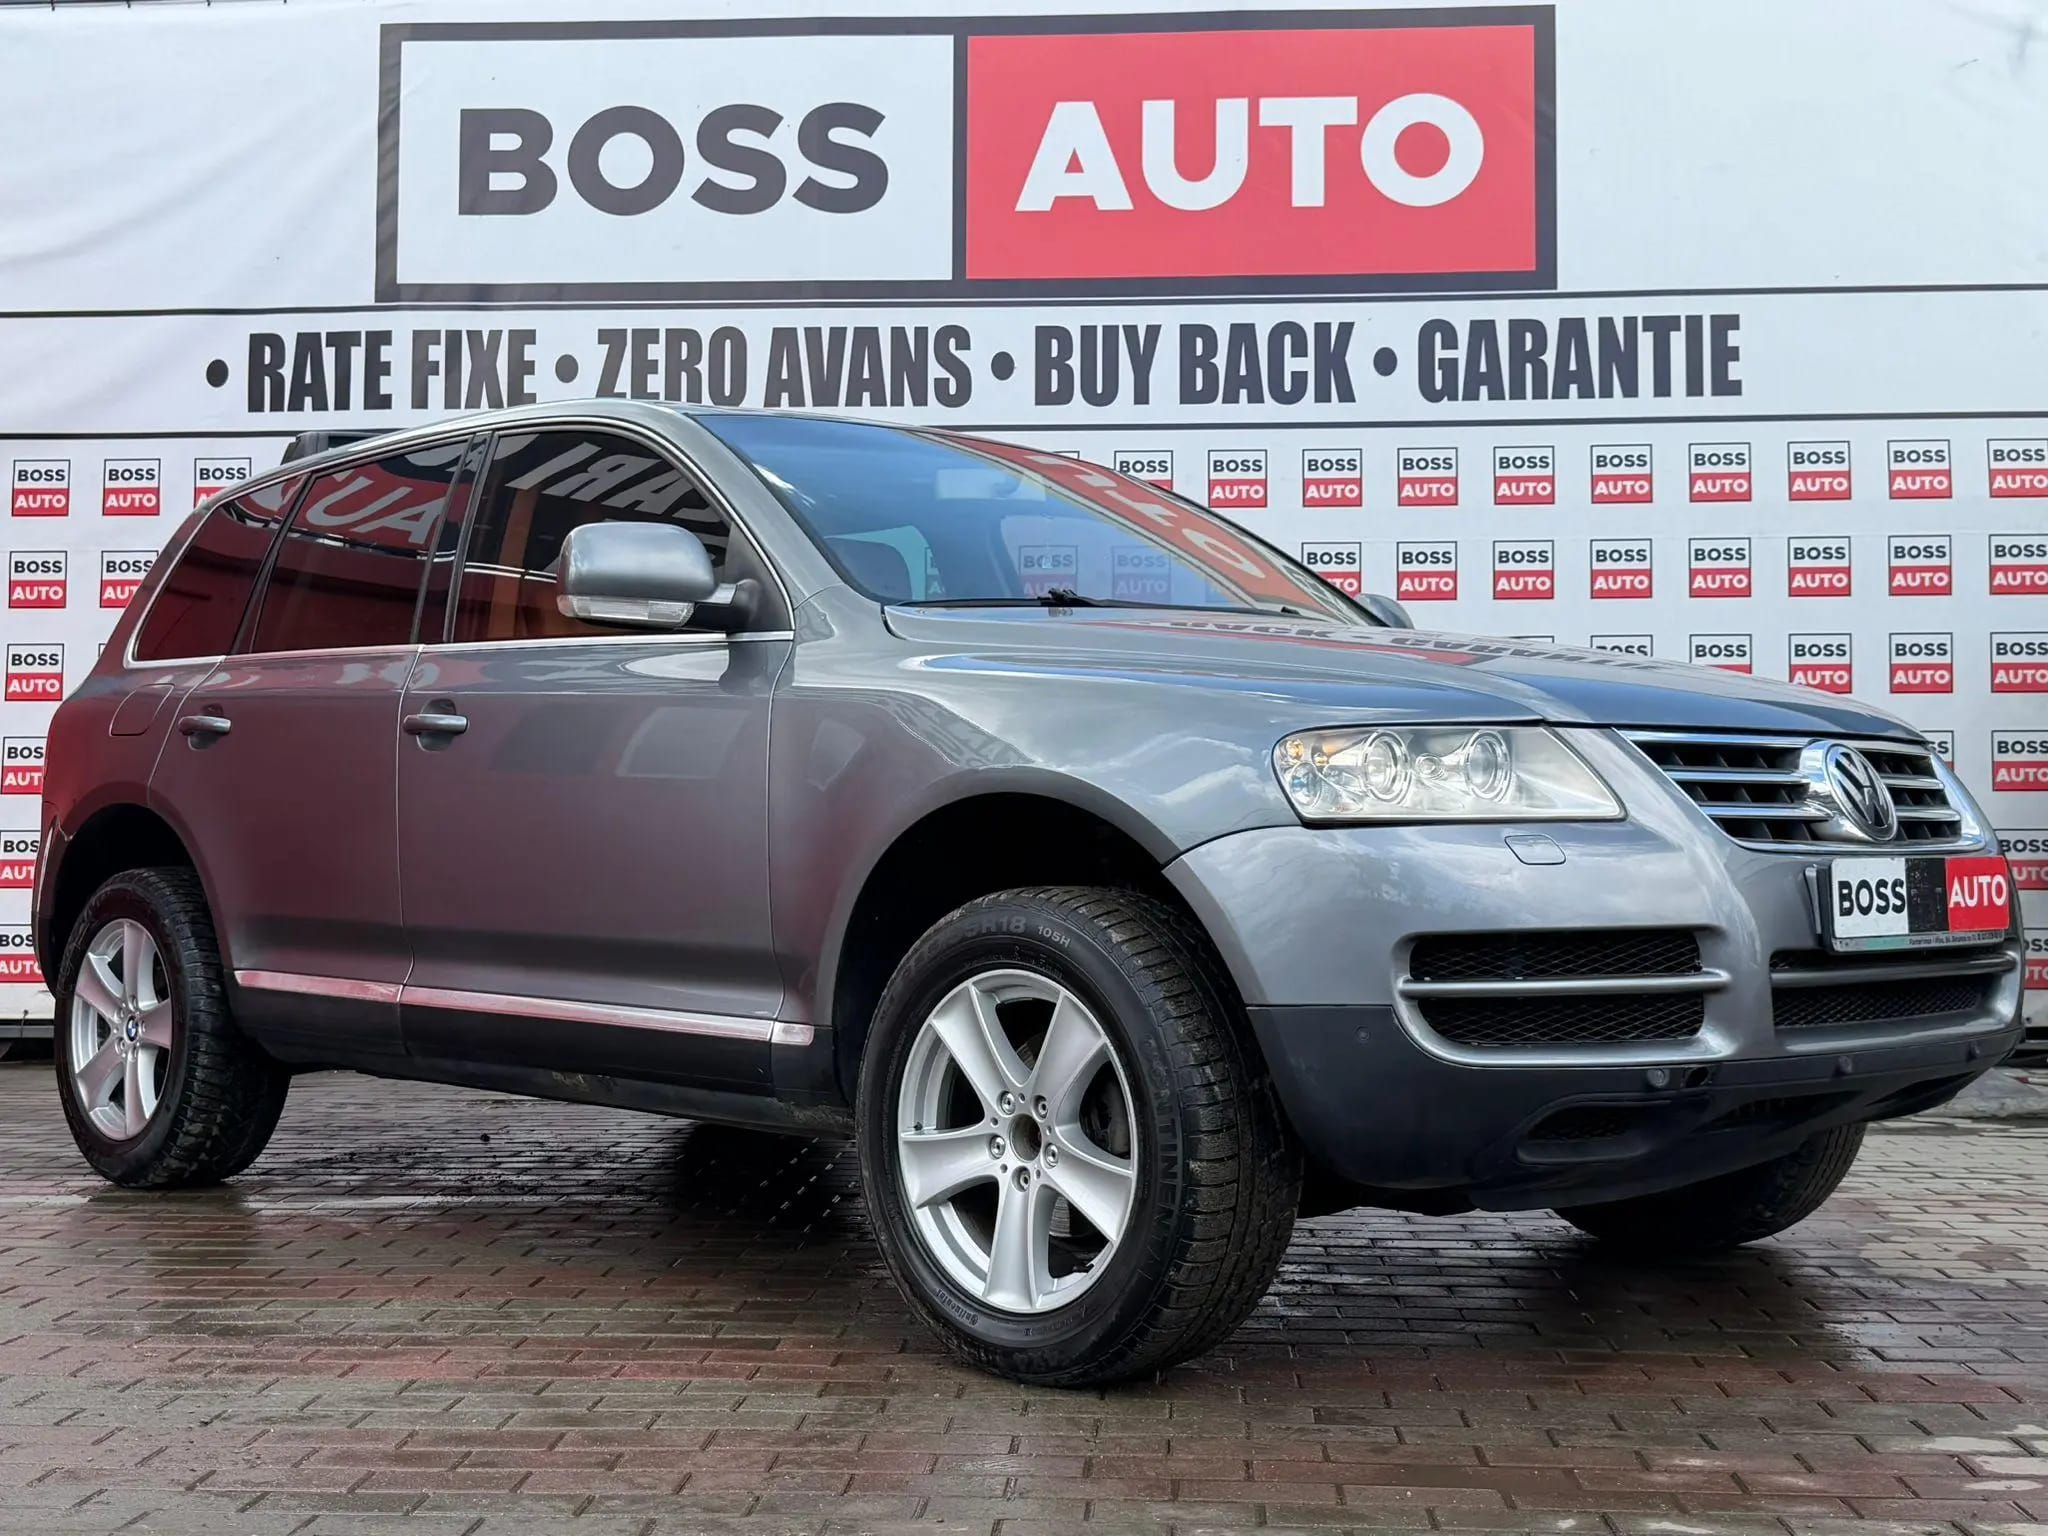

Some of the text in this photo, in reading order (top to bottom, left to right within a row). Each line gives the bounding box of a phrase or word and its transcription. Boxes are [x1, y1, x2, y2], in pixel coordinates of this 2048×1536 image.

[457, 91, 1486, 217] BOSS AUTO
[248, 312, 1744, 413] RATE FIXE ZERO AVANS BUY BACK GARANTIE
[1498, 455, 1550, 470] BOSS
[1596, 453, 1648, 468] BOSS
[1694, 452, 1747, 467] BOSS
[1793, 450, 1846, 465] BOSS
[1893, 449, 1946, 464] BOSS
[1992, 448, 2046, 462] BOSS
[1119, 460, 1169, 473] BOSS
[1213, 459, 1263, 473] BOSS
[1307, 458, 1358, 472] BOSS
[1402, 457, 1454, 471] BOSS
[17, 468, 66, 482] BOSS
[108, 467, 156, 482] BOSS
[199, 467, 247, 481] BOSS
[1992, 474, 2048, 489] AUTO
[1400, 482, 1455, 498] AUTO
[1496, 481, 1552, 497] AUTO
[1593, 480, 1650, 496] AUTO
[1692, 478, 1749, 494] AUTO
[1791, 477, 1849, 492] AUTO
[1892, 475, 1949, 491] AUTO
[1210, 484, 1265, 500] AUTO
[1305, 484, 1360, 499] AUTO
[14, 494, 67, 508] AUTO
[105, 493, 157, 508] AUTO
[1401, 550, 1453, 565] BOSS
[1498, 550, 1549, 564] BOSS
[1595, 548, 1648, 563] BOSS
[1694, 547, 1746, 562] BOSS
[1793, 546, 1846, 561] BOSS
[1893, 544, 1947, 560] BOSS
[1994, 543, 2048, 558] BOSS
[1306, 551, 1357, 566] BOSS
[14, 560, 63, 574] BOSS
[1400, 577, 1455, 592] AUTO
[1496, 576, 1551, 591] AUTO
[1593, 575, 1650, 590] AUTO
[1692, 574, 1749, 589] AUTO
[1791, 573, 1848, 588] AUTO
[1891, 572, 1949, 587] AUTO
[1992, 571, 2048, 586] AUTO
[11, 585, 64, 601] AUTO
[102, 586, 138, 601] AUT
[1695, 644, 1747, 658] BOSS
[1794, 643, 1847, 658] BOSS
[1895, 642, 1948, 657] BOSS
[1995, 641, 2048, 656] BOSS
[11, 653, 59, 667] BOSS
[1793, 670, 1849, 686] AUTO
[1892, 669, 1951, 685] AUTO
[1993, 669, 2048, 684] AUTO
[7, 678, 60, 693] AUTO
[7, 746, 44, 760] BOS
[1997, 740, 2048, 755] BOSS
[3, 772, 43, 787] AUT
[1995, 767, 2048, 783] AUTO
[2, 839, 40, 853] BOS
[0, 865, 36, 880] AUT
[1838, 874, 2007, 917] BOSS AUTO
[0, 933, 33, 948] BOS
[1037, 924, 1072, 949] 105H
[0, 959, 42, 975] AUT
